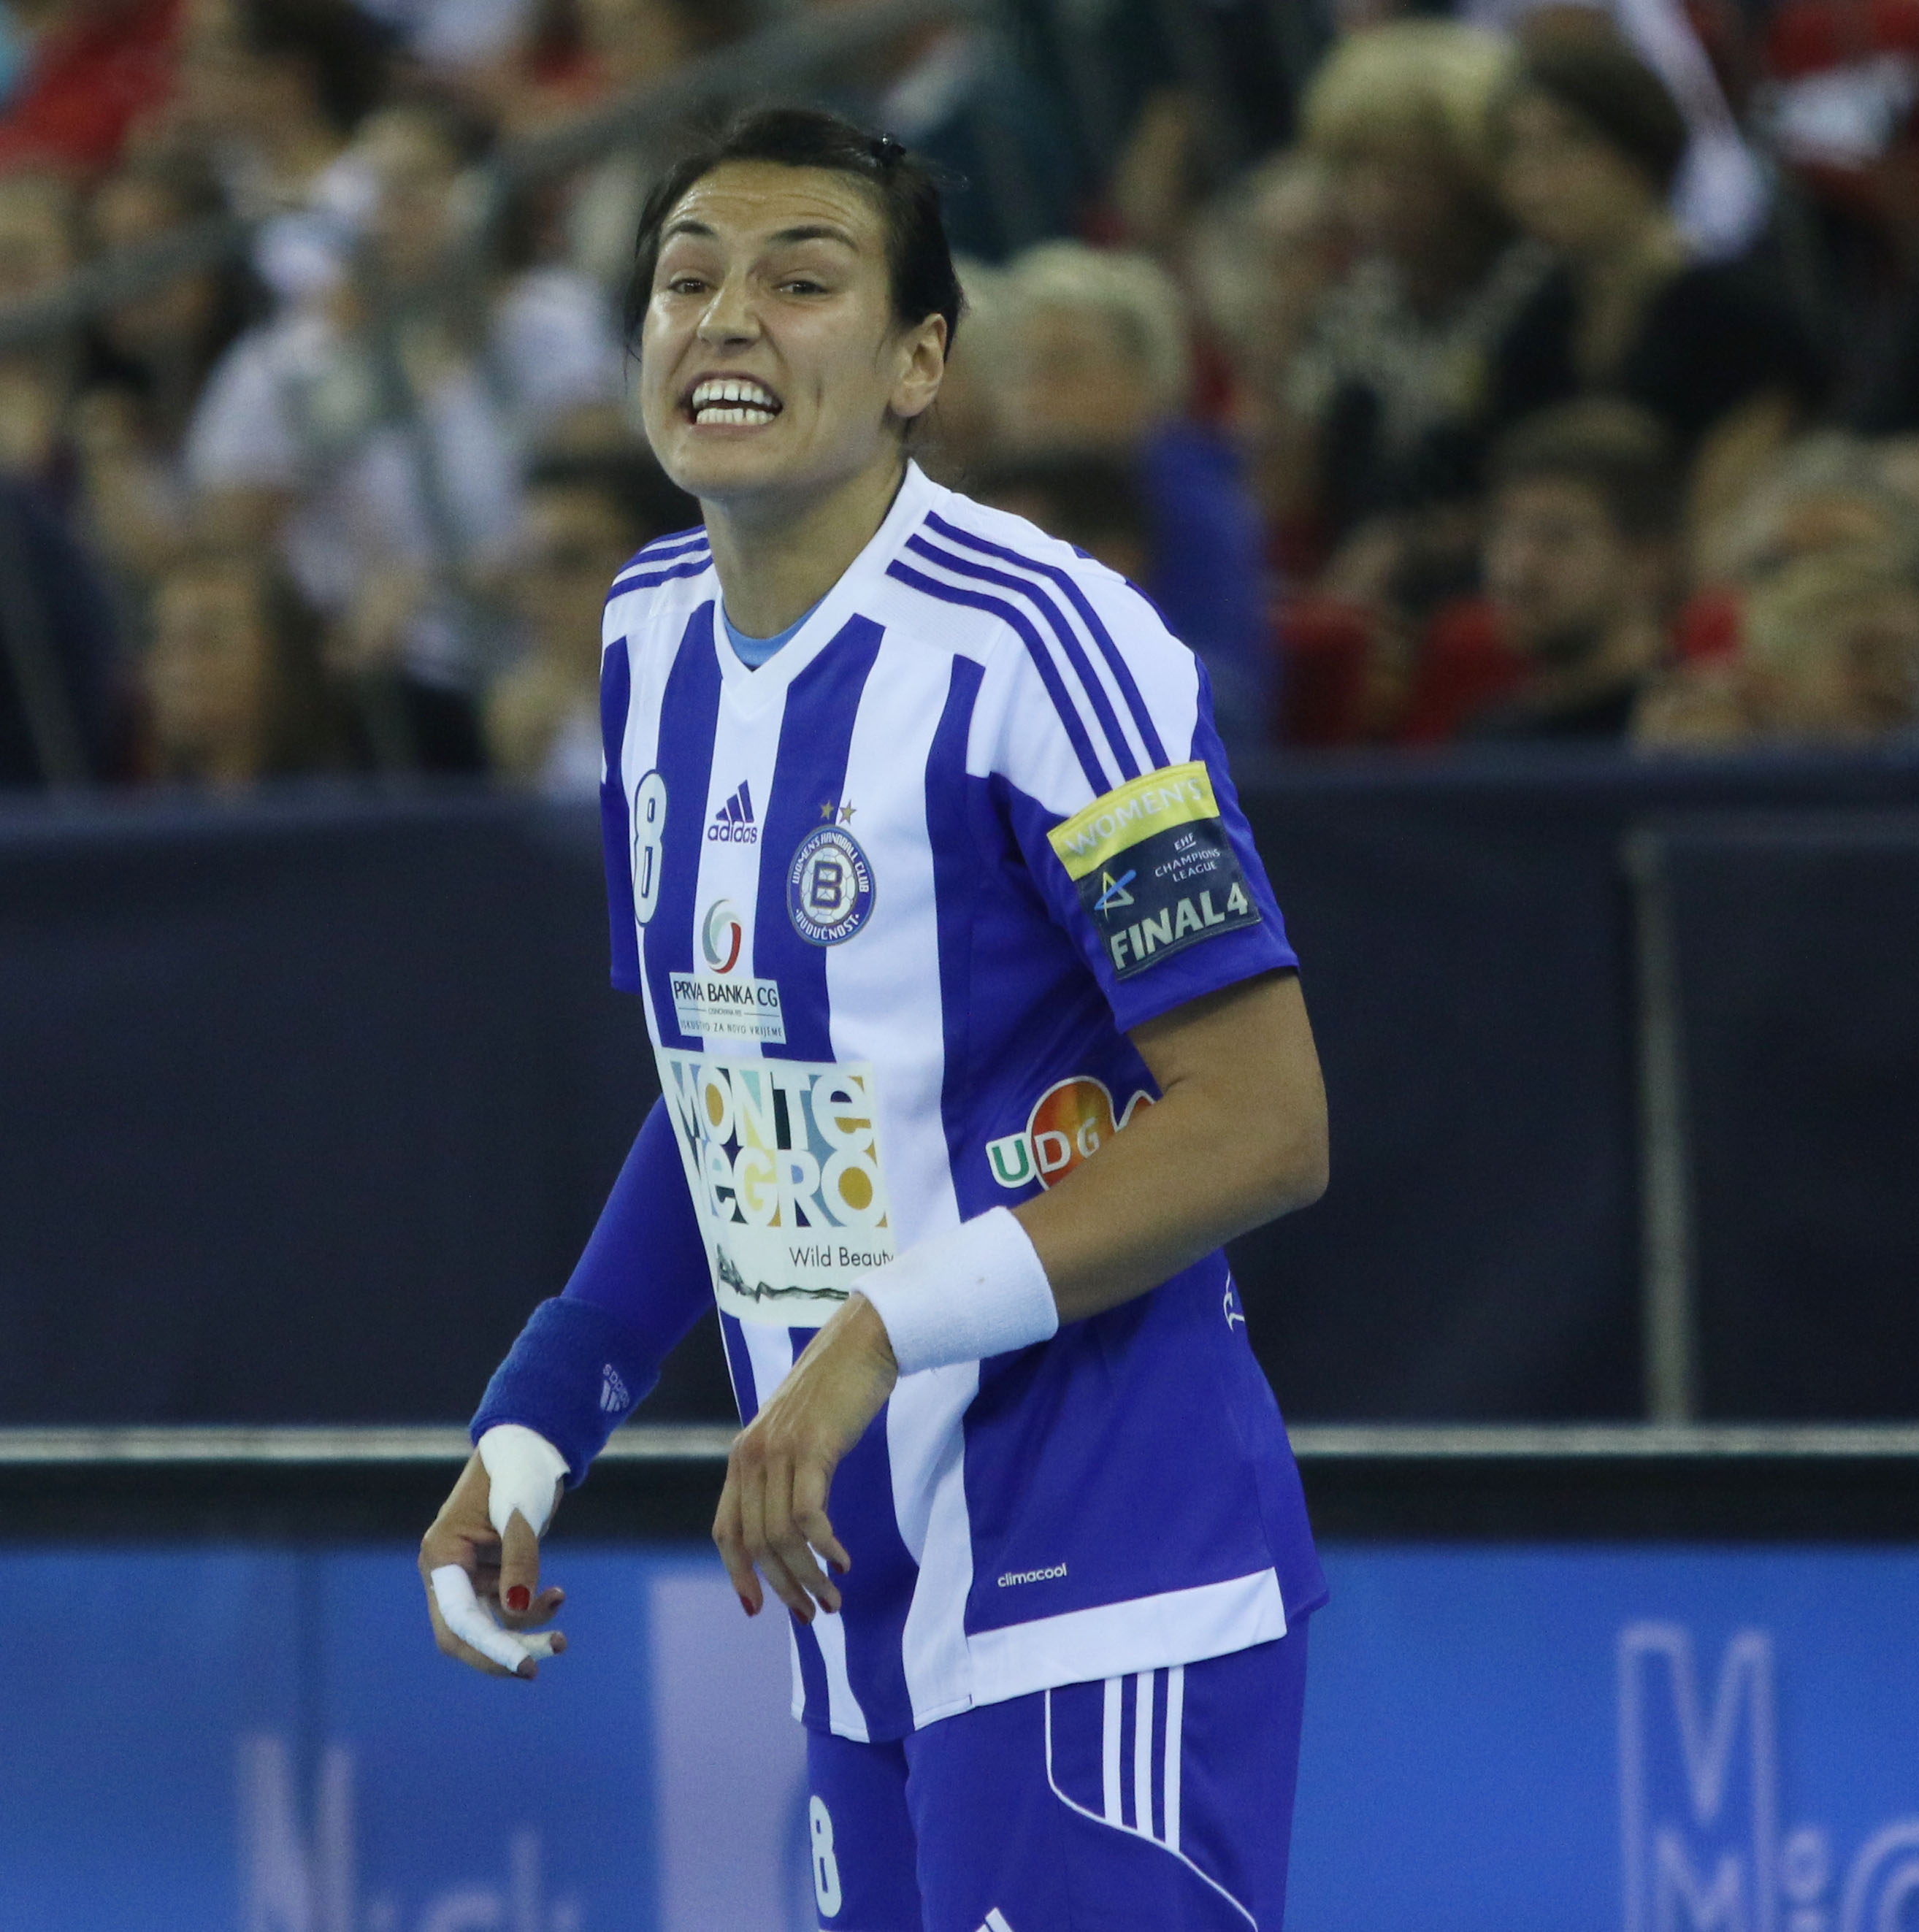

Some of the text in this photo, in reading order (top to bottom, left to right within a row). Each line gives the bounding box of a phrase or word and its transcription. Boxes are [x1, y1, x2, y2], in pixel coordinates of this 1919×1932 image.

[1065, 778, 1204, 855] WOMEN'S
[708, 821, 757, 843] adidas
[1174, 832, 1195, 851] EHF
[634, 769, 667, 927] 8
[792, 832, 869, 893] WOMEN'S HANDBALL CLUB
[1155, 848, 1220, 877] CHAMPIONS
[810, 860, 843, 909] B
[1173, 862, 1217, 882] LEAGUE
[1110, 881, 1248, 970] FINAL 4
[673, 981, 778, 1008] PRVA BANKA CG
[714, 1022, 724, 1032] ZA
[992, 1117, 1100, 1181] UDG
[789, 1245, 832, 1268] Wild
[997, 1563, 1067, 1587] climacool
[809, 1795, 842, 1918] 8
